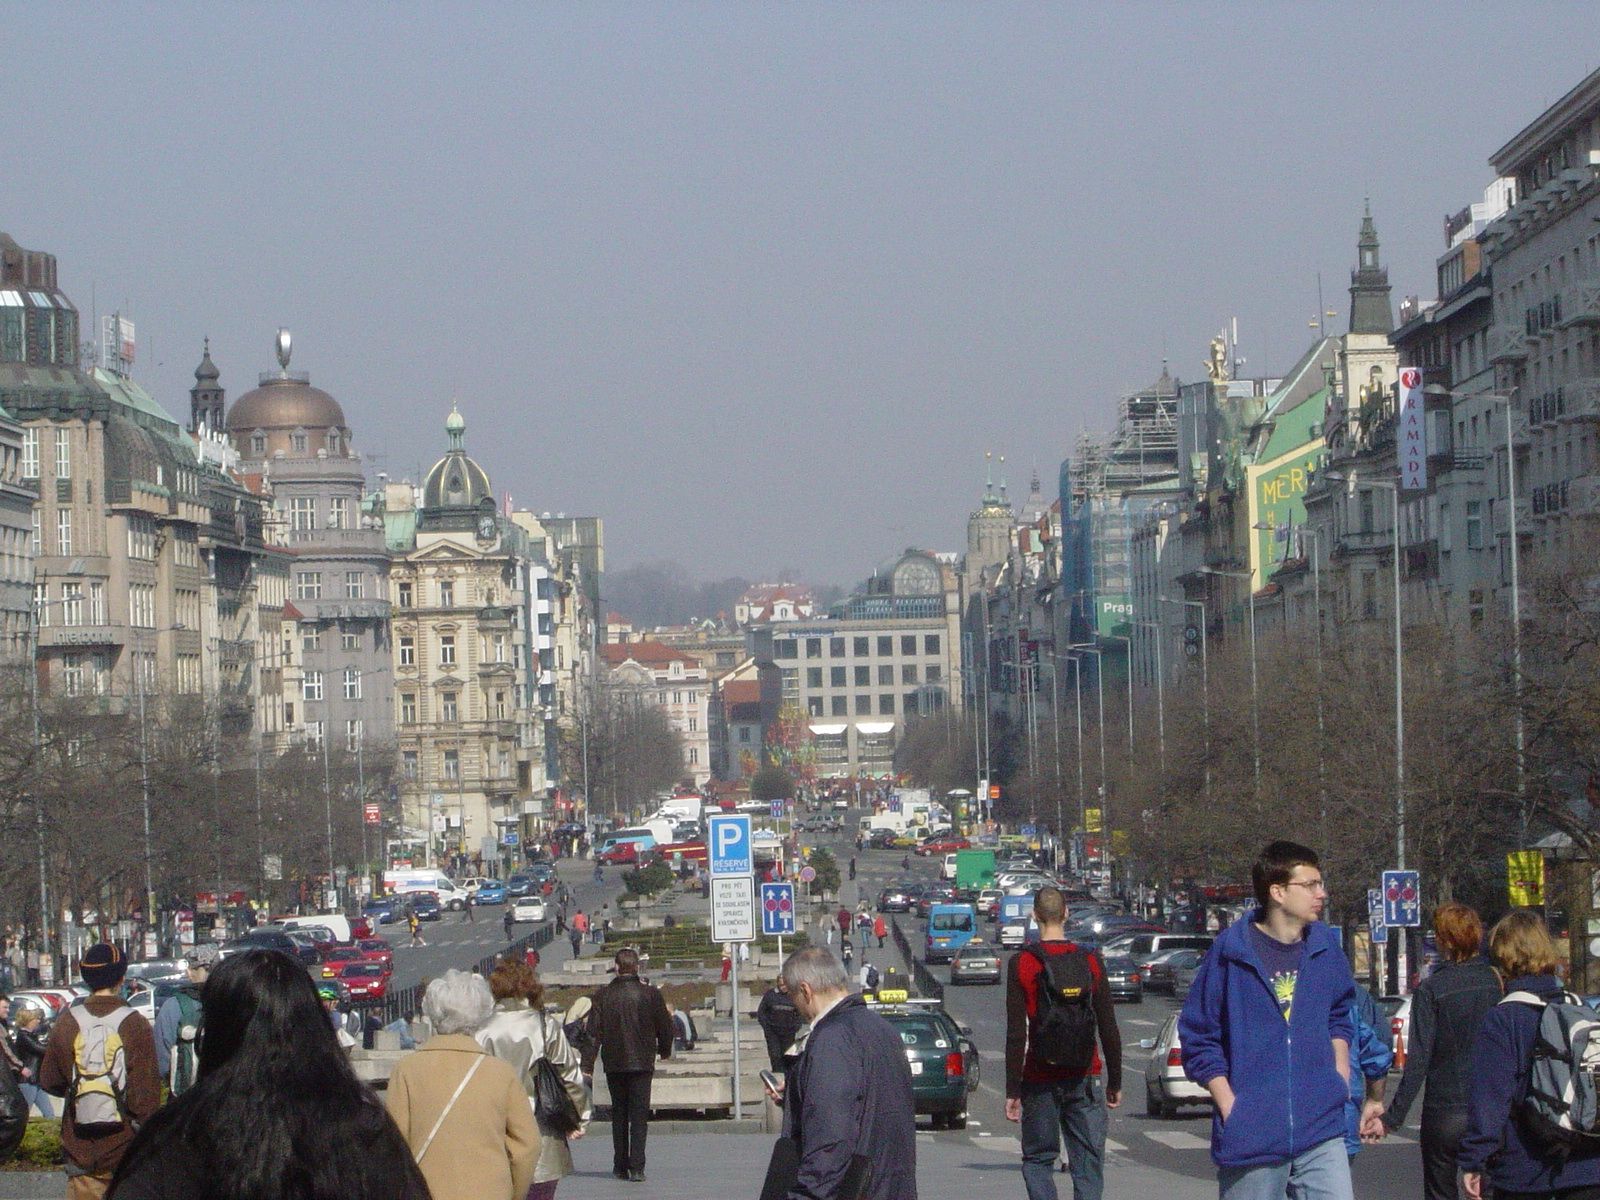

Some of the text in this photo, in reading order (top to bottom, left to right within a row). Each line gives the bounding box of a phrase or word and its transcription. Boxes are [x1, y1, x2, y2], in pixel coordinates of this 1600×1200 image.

[1407, 398, 1419, 488] RAMADA
[1103, 602, 1133, 615] Prag
[718, 823, 743, 858] P
[882, 992, 905, 1001] TAXI
